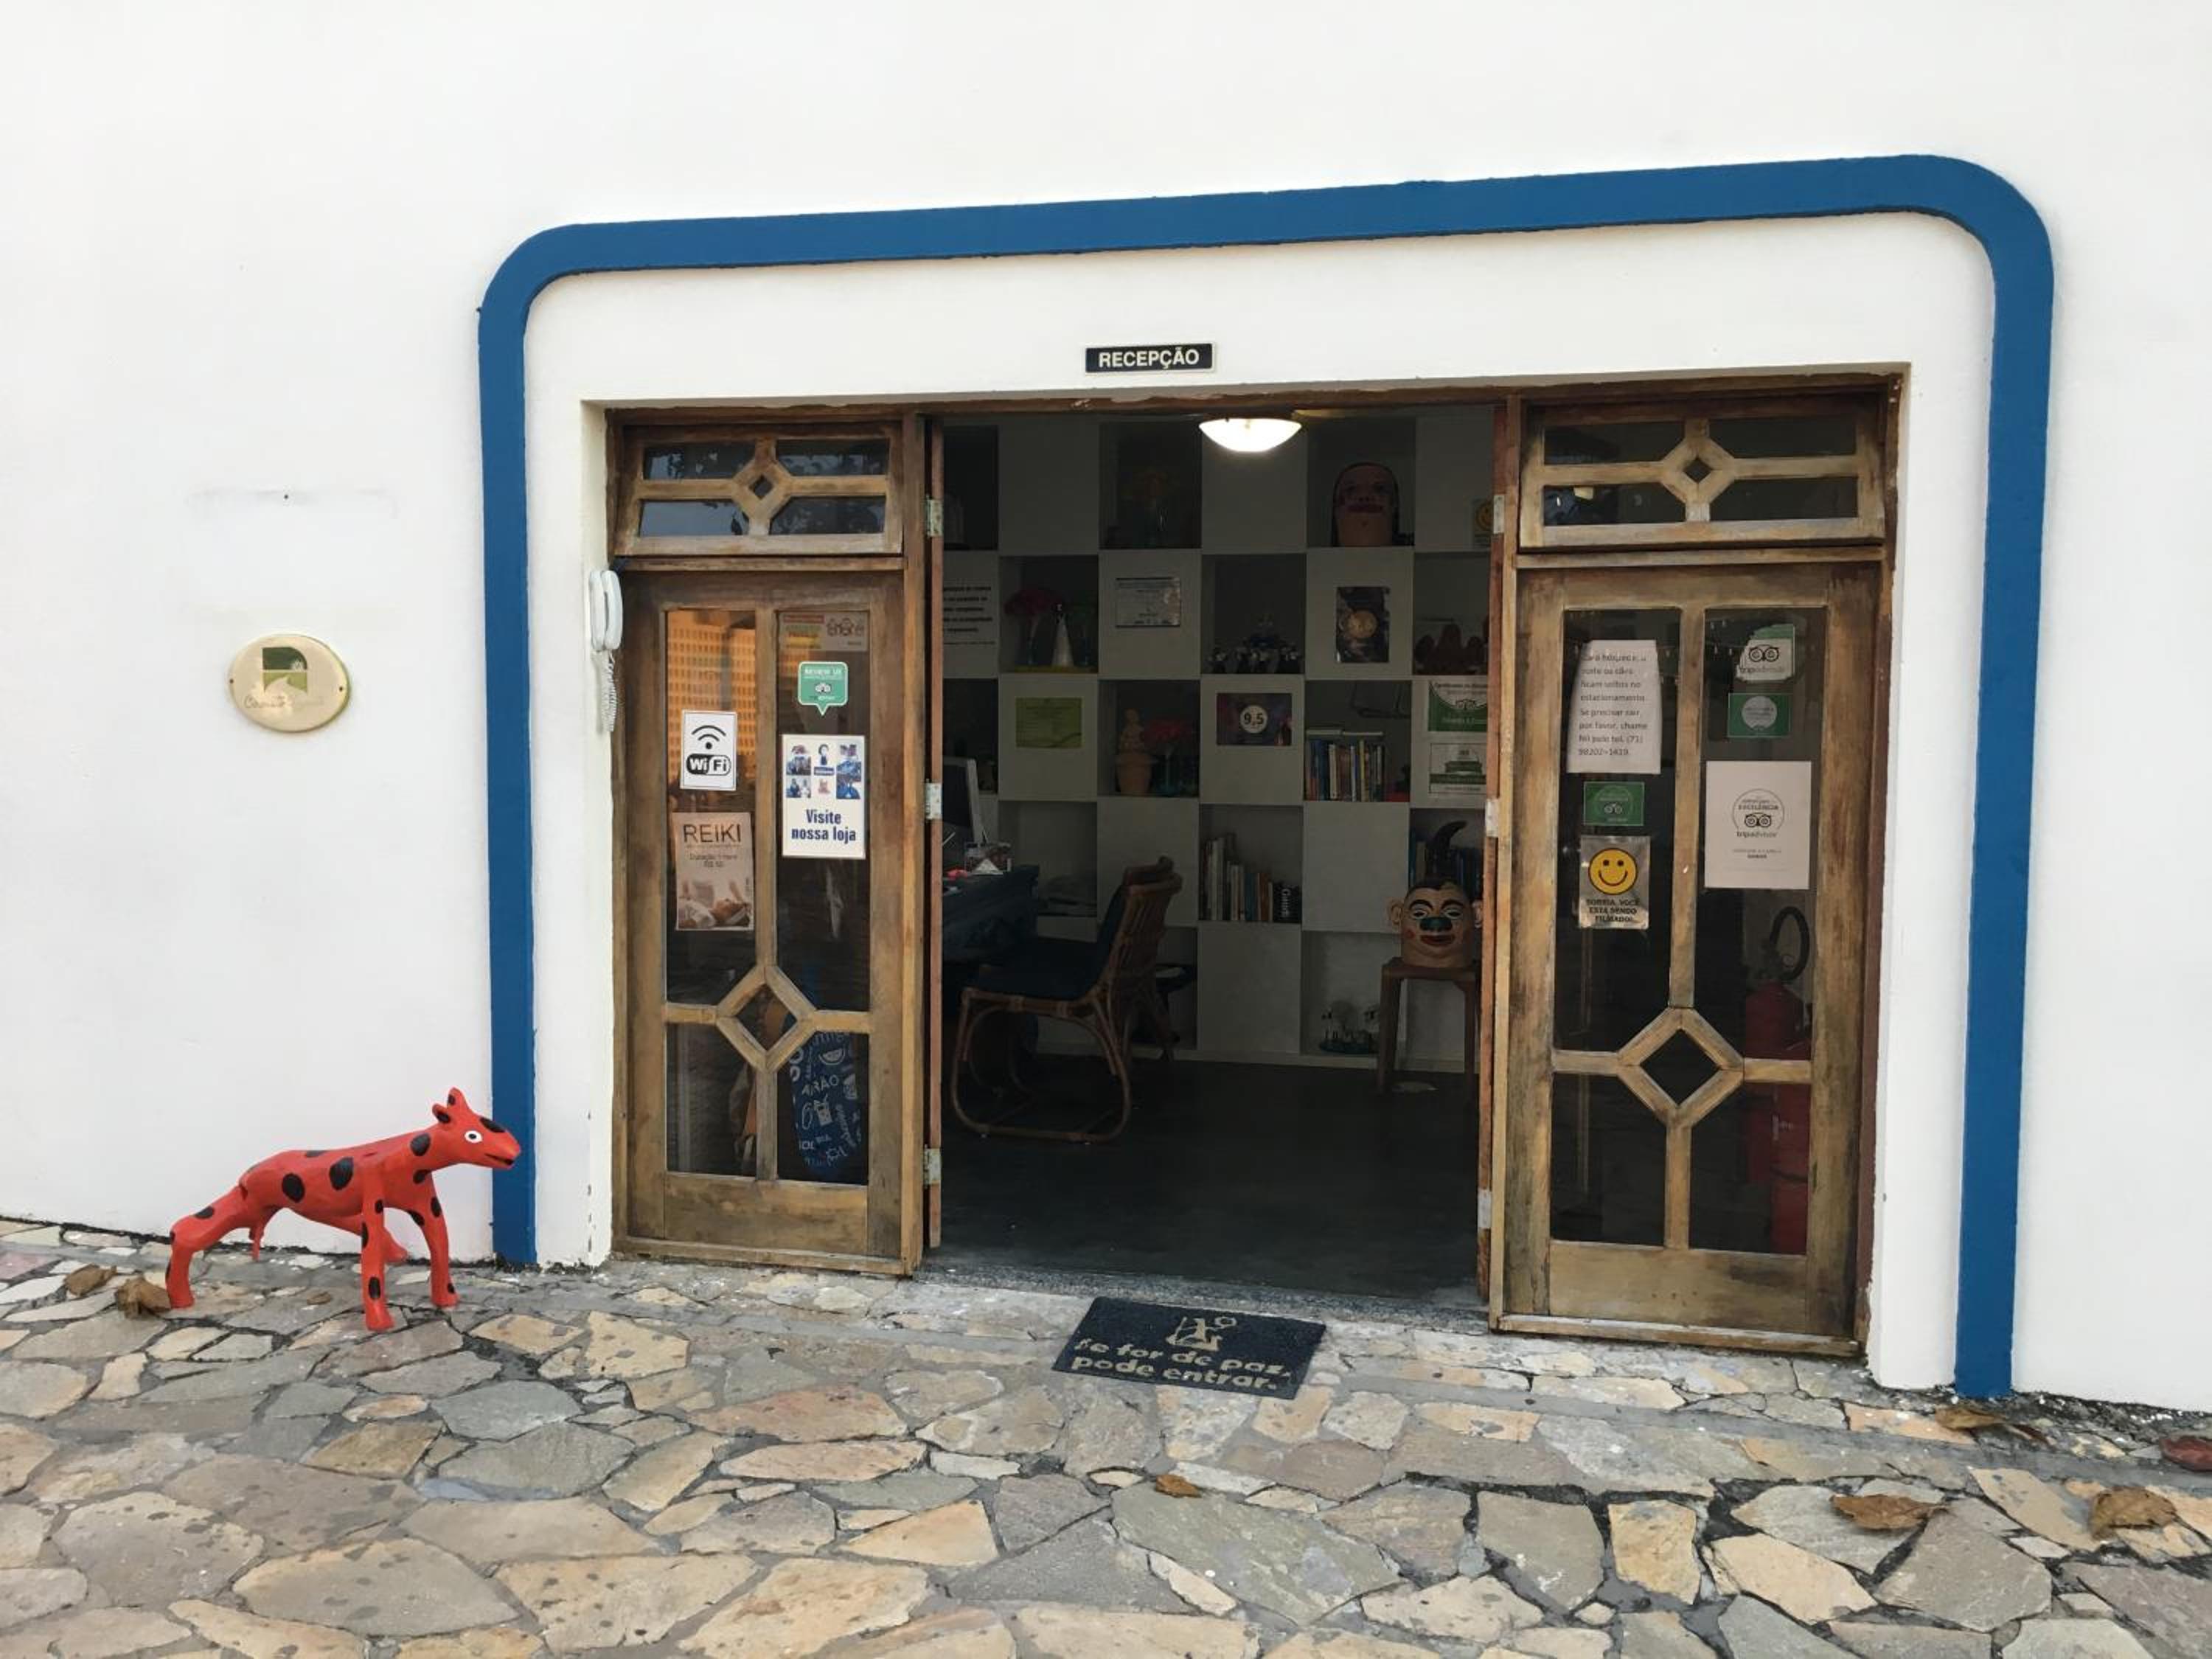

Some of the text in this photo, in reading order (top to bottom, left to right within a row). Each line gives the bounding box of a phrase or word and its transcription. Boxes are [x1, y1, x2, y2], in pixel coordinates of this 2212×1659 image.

[1099, 347, 1200, 369] RECEPÇÃO
[806, 809, 842, 824] Visite
[684, 824, 741, 843] REIKI
[791, 826, 856, 844] nossa loja
[1071, 1356, 1155, 1377] pode
